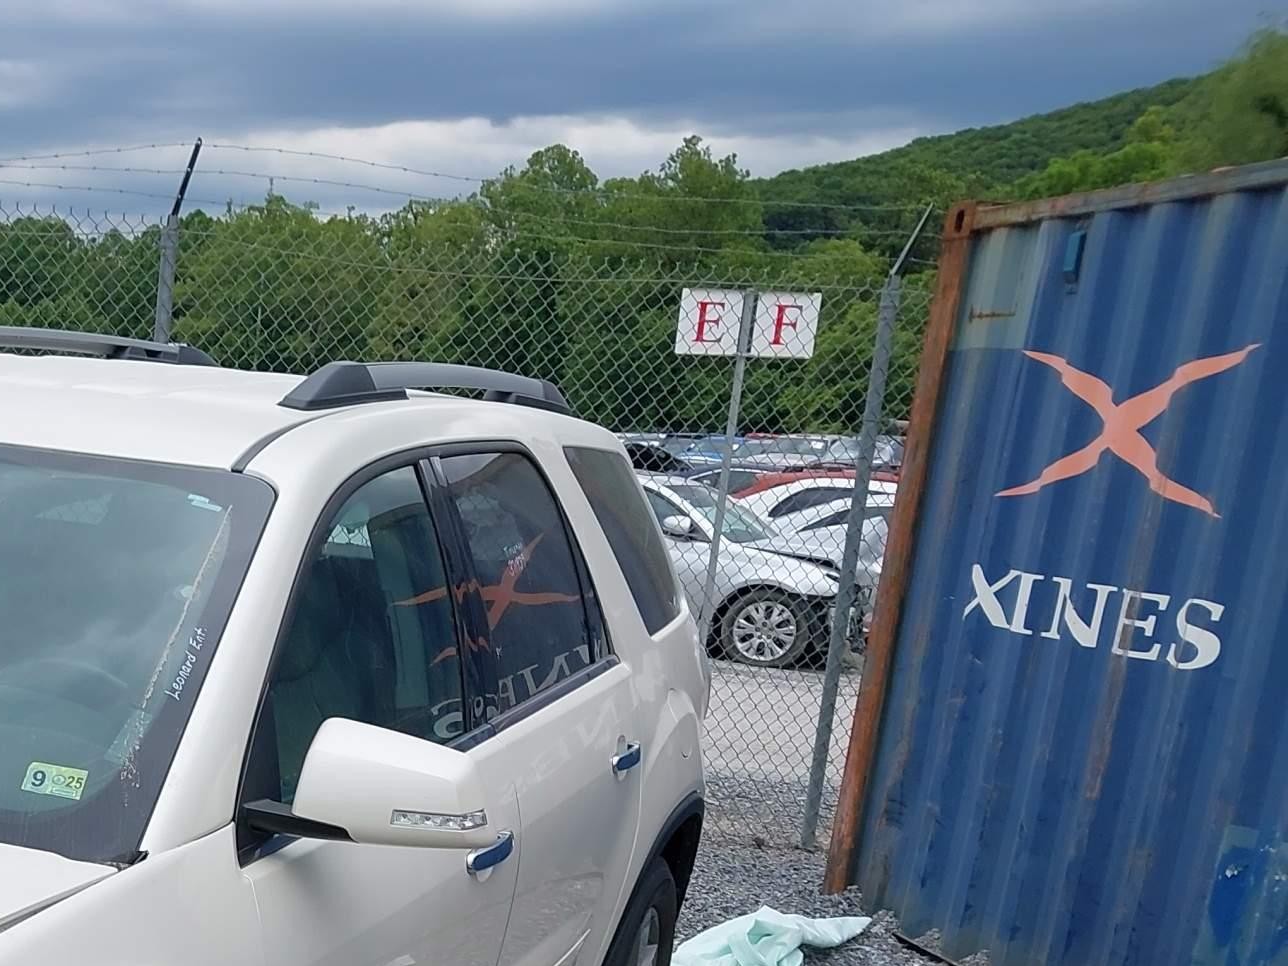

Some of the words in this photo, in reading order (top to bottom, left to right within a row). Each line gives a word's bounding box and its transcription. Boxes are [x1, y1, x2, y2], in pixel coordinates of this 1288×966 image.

[692, 301, 726, 343] E
[769, 304, 803, 346] F
[963, 563, 1225, 670] XINES
[163, 650, 197, 701] Leonard
[31, 770, 47, 787] 9
[65, 775, 84, 790] 25
